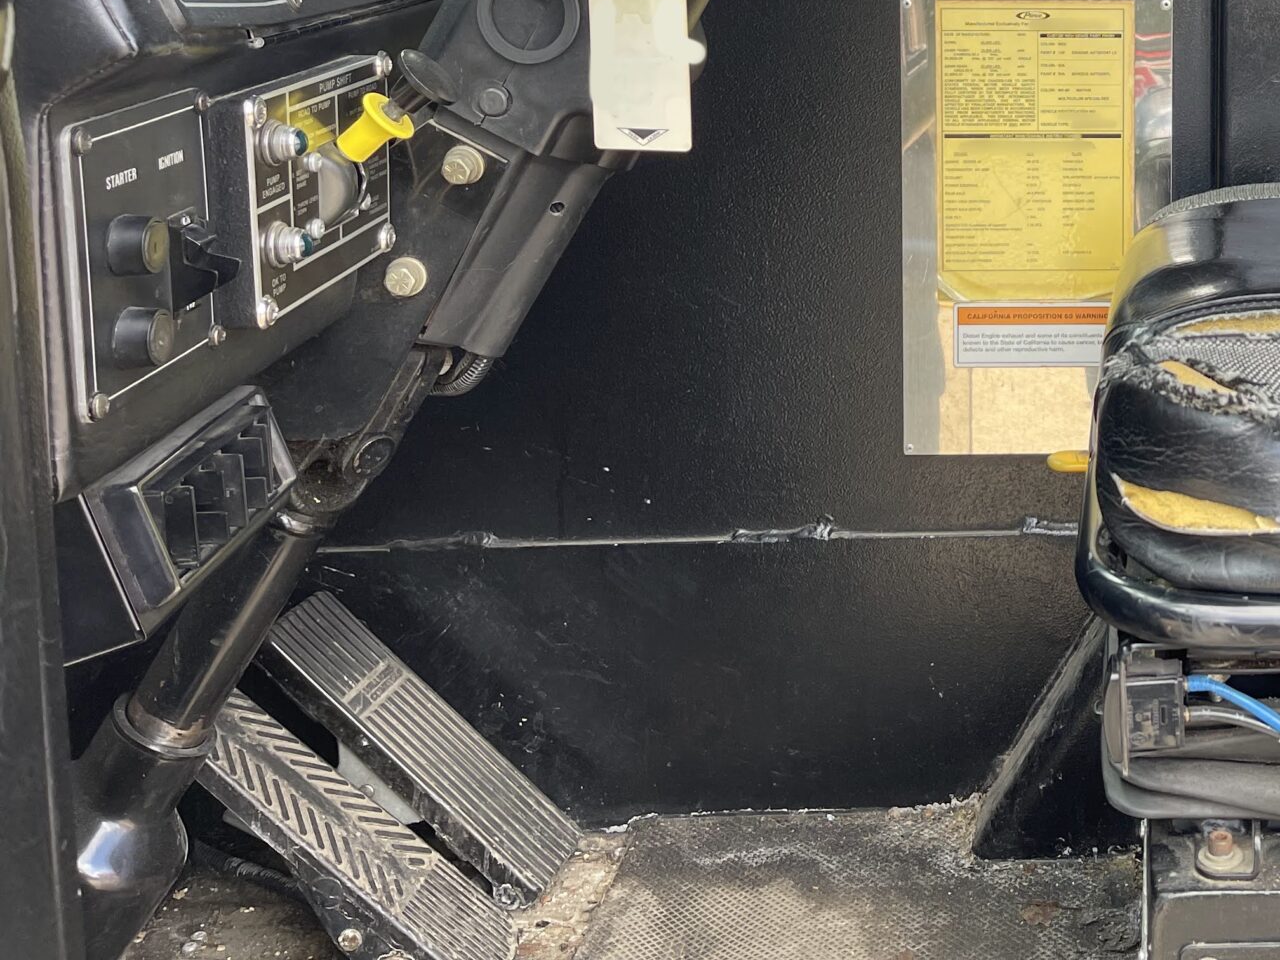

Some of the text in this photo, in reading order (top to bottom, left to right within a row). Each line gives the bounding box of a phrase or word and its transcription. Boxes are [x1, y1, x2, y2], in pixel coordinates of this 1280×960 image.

[320, 73, 352, 93] PUMP SHIFT
[311, 105, 318, 113] TO
[319, 100, 330, 110] PUMP
[158, 149, 184, 170] IGNITION
[106, 168, 137, 190] STARTER
[267, 174, 280, 186] PUMP
[262, 182, 286, 199] ENGAGED
[272, 273, 286, 288] OK TO
[273, 283, 286, 297] PUMP
